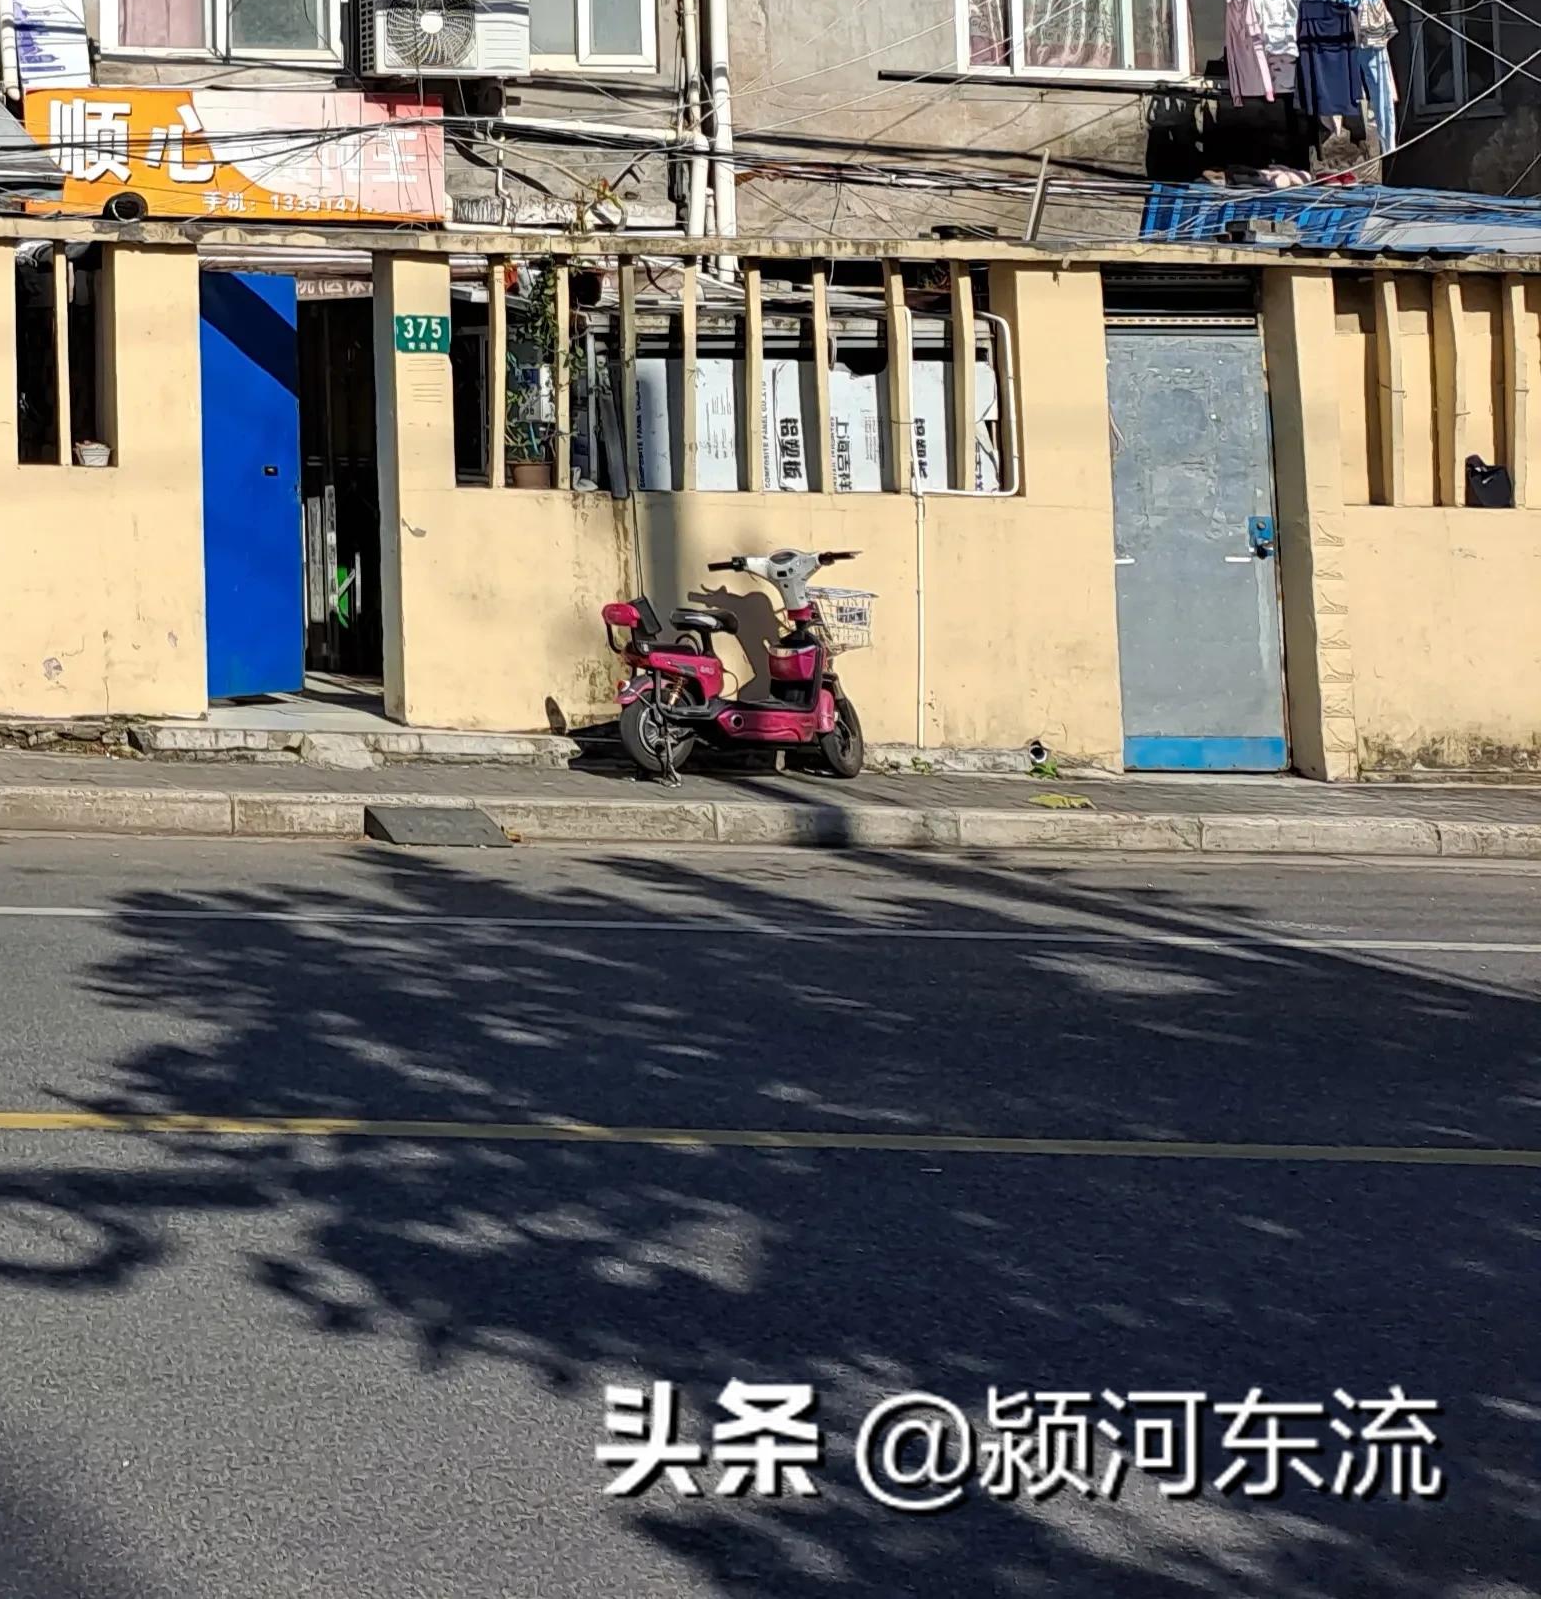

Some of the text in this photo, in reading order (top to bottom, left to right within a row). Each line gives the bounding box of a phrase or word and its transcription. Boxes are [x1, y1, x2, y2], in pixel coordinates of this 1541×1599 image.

[49, 97, 216, 185] 顺心
[403, 317, 443, 339] 375
[779, 417, 803, 480] 铝塑板
[835, 416, 853, 491] 上海吉祥
